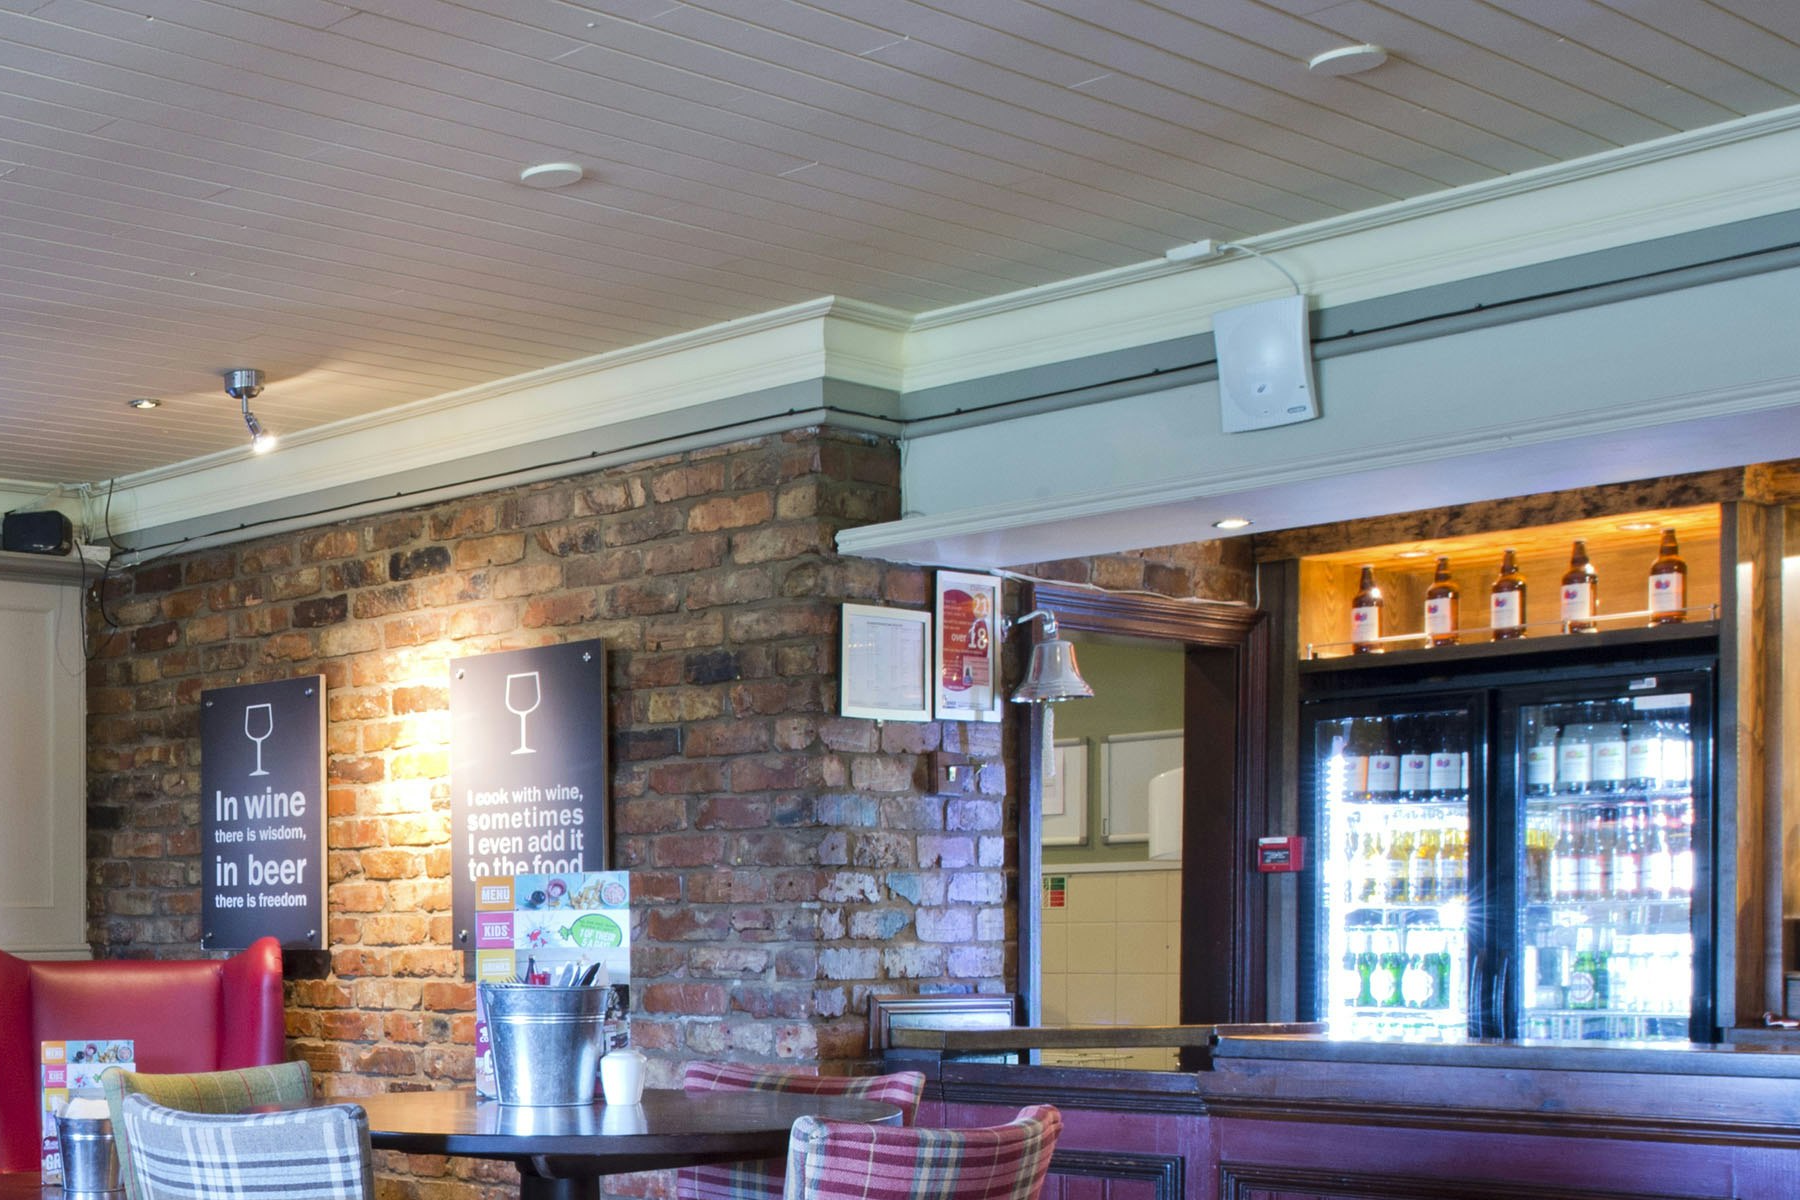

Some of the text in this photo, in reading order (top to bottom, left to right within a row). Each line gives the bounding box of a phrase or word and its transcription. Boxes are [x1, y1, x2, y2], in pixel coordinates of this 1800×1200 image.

[968, 623, 987, 650] 18
[216, 786, 306, 821] In wine
[467, 784, 583, 807] I cook with wine,
[467, 806, 584, 831] sometimes
[215, 825, 306, 843] there is wisdom,
[468, 828, 584, 856] I even add it
[216, 854, 307, 886] in beer
[468, 852, 584, 882] to the food
[215, 892, 307, 908] there is freedom
[481, 886, 510, 902] MENU
